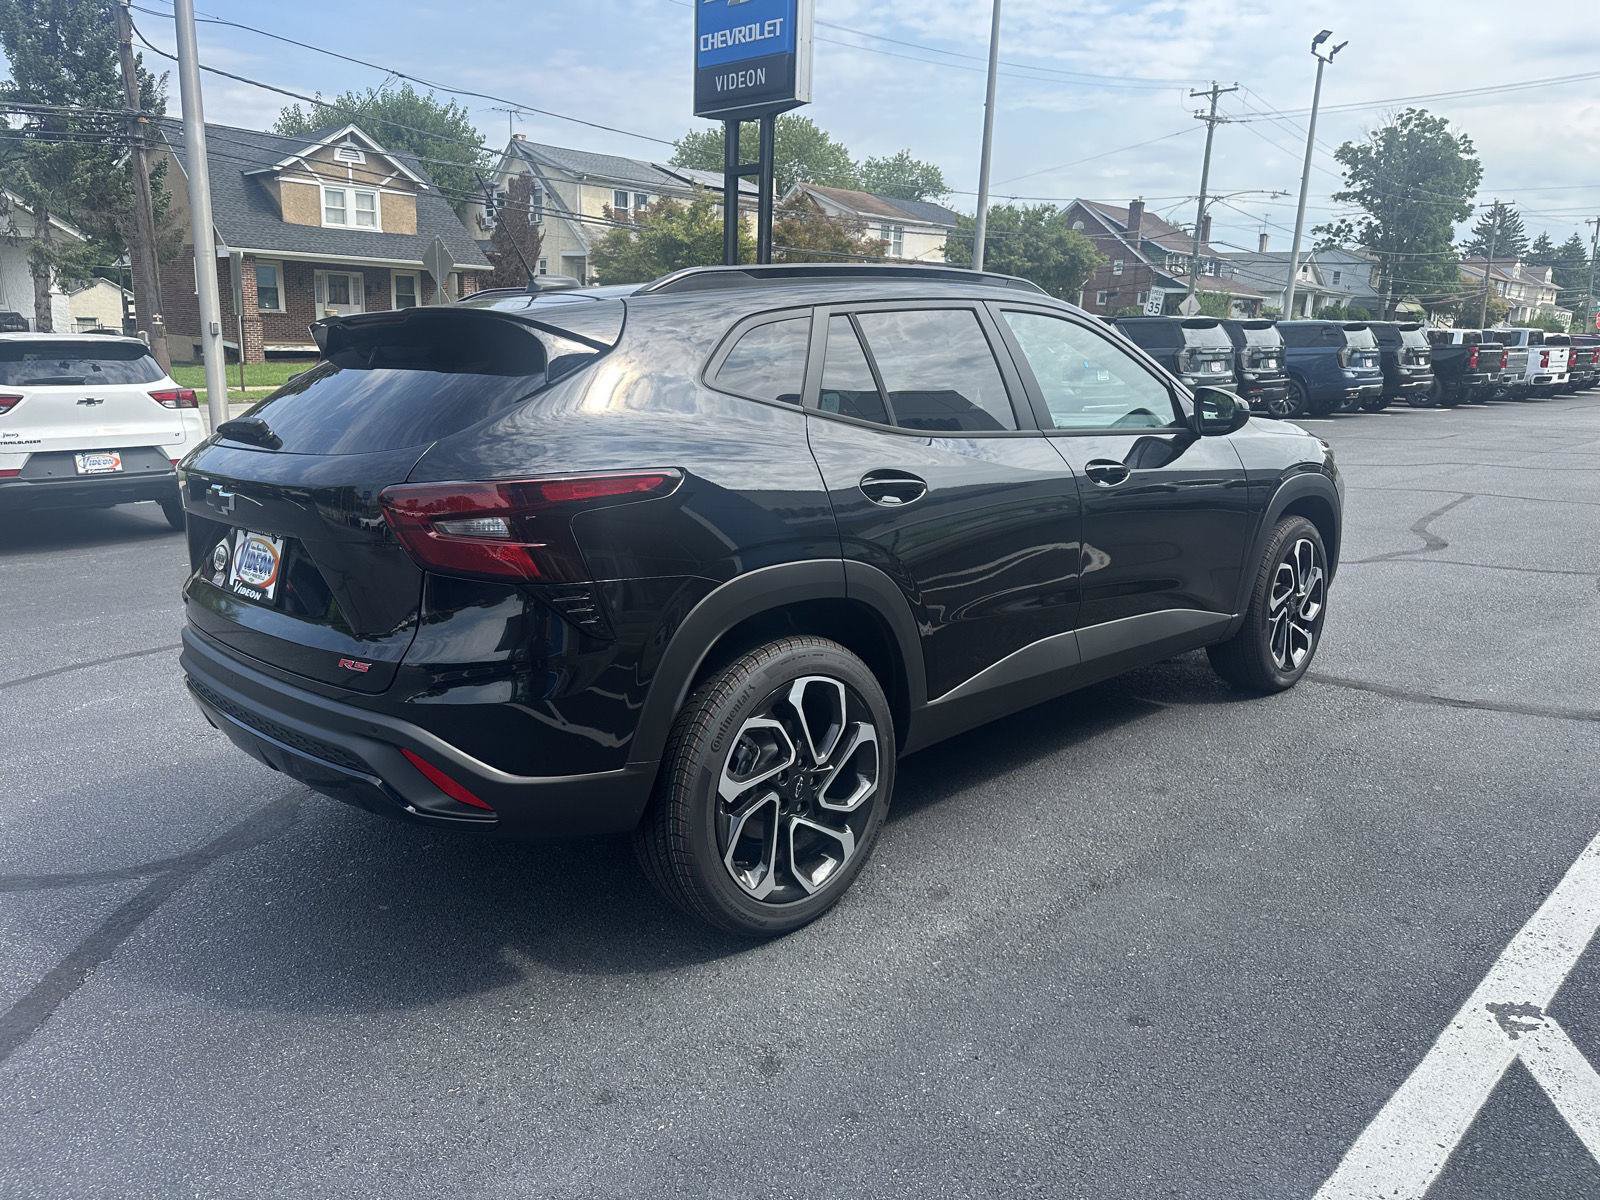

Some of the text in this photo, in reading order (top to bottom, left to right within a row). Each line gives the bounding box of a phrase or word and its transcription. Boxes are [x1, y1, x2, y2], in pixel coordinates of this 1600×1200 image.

[700, 18, 784, 52] CHEVROLET
[715, 67, 766, 92] VIDEON
[1148, 302, 1160, 314] 35
[338, 658, 372, 673] RS
[710, 691, 752, 754] Continental
